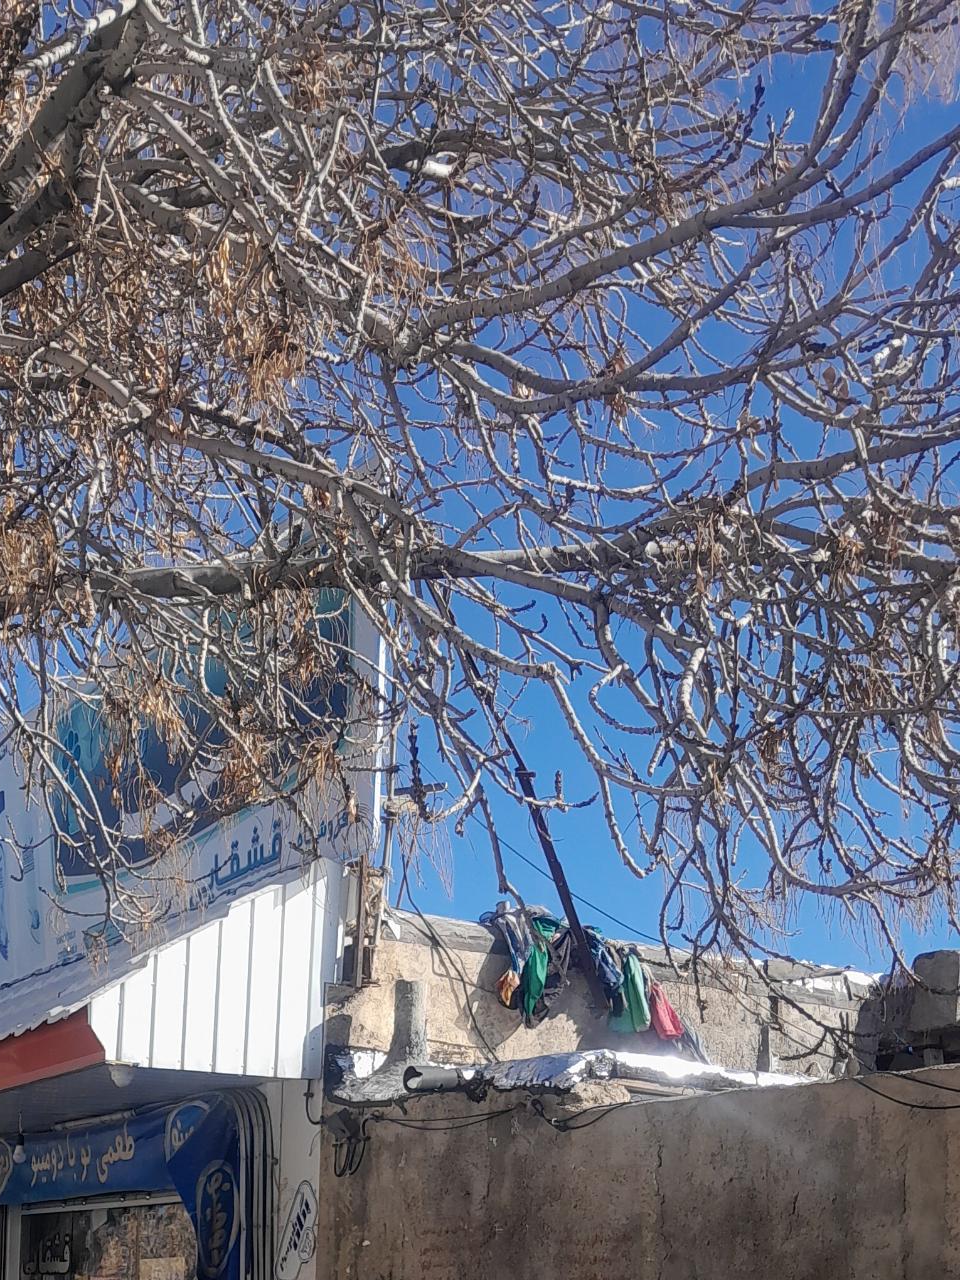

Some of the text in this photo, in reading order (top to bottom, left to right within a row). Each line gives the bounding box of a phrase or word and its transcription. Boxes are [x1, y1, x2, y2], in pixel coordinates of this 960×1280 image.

[31, 1122, 136, 1188] طعمی نو با دومینو
